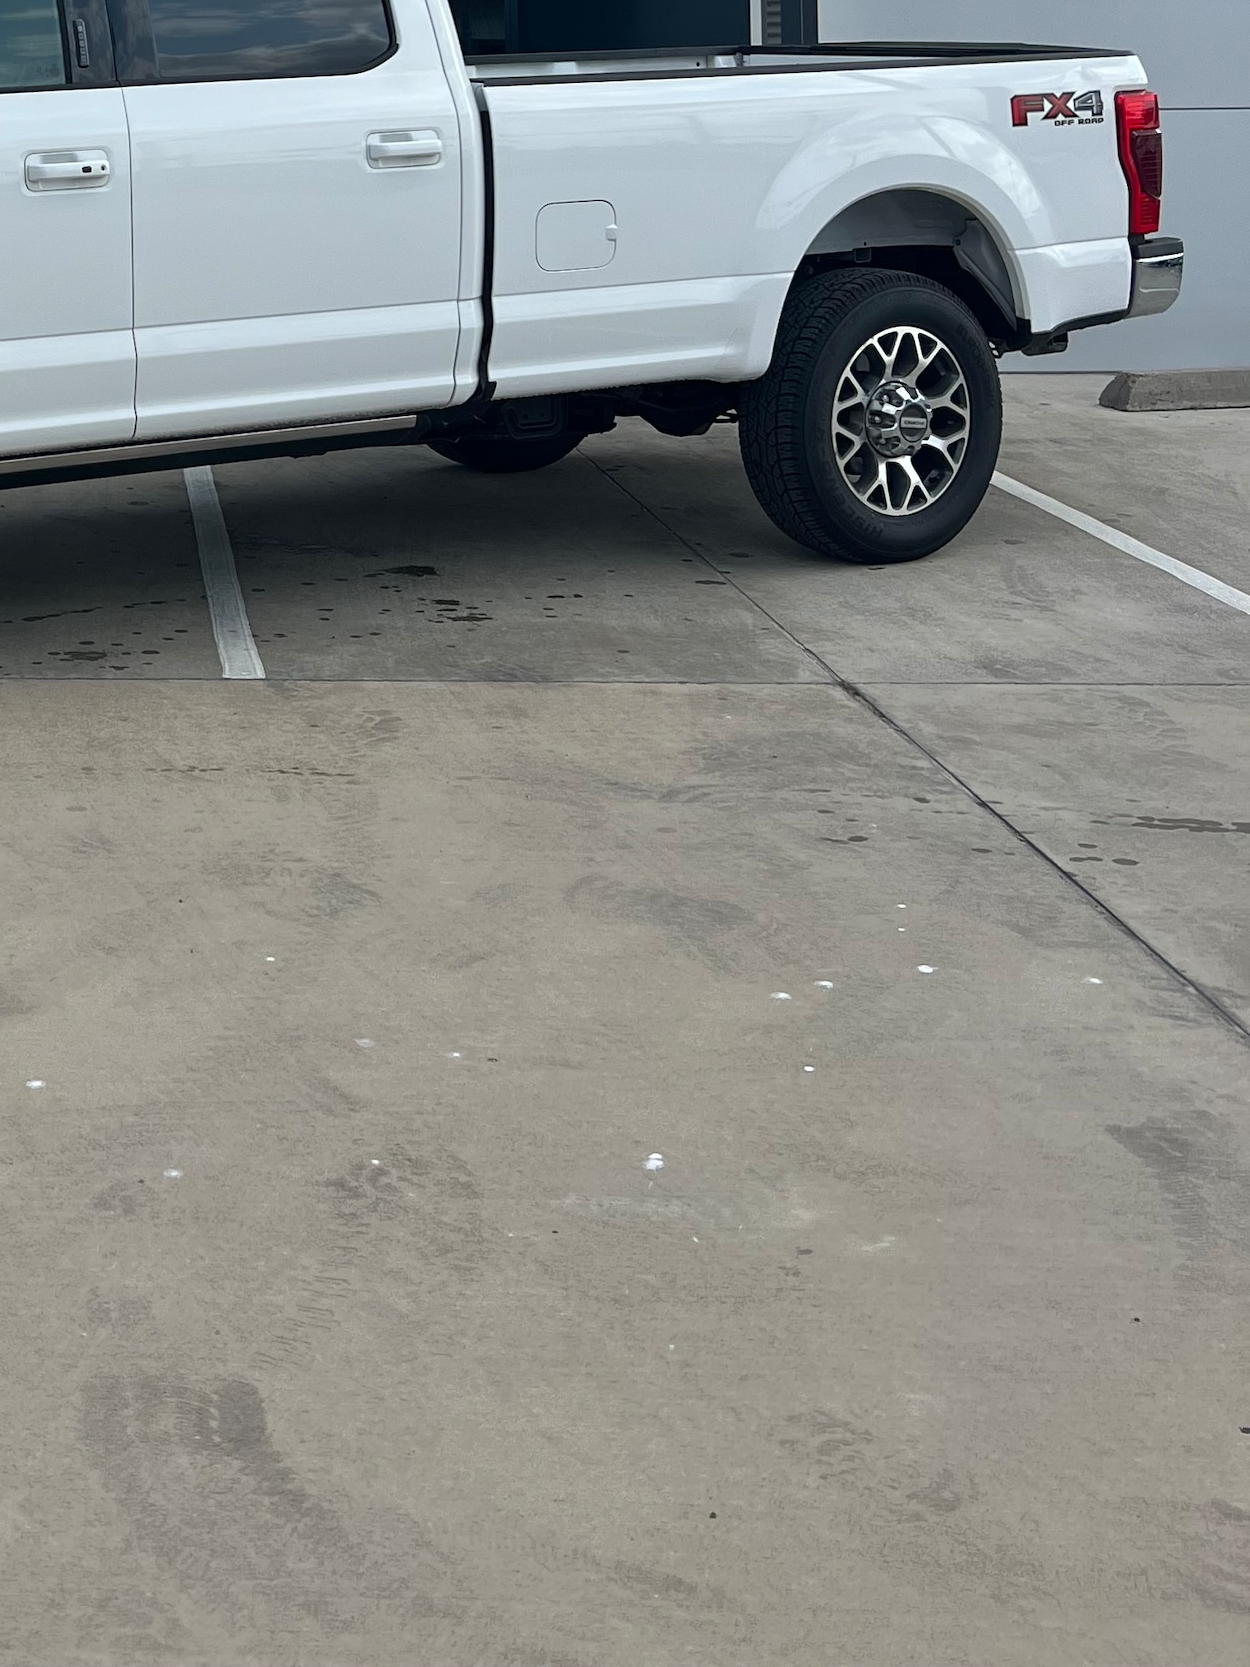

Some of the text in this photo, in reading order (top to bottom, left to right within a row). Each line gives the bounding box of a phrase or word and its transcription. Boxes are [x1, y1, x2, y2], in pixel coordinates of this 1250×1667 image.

[1010, 90, 1103, 127] FX4
[1054, 117, 1104, 127] OFF ROAD
